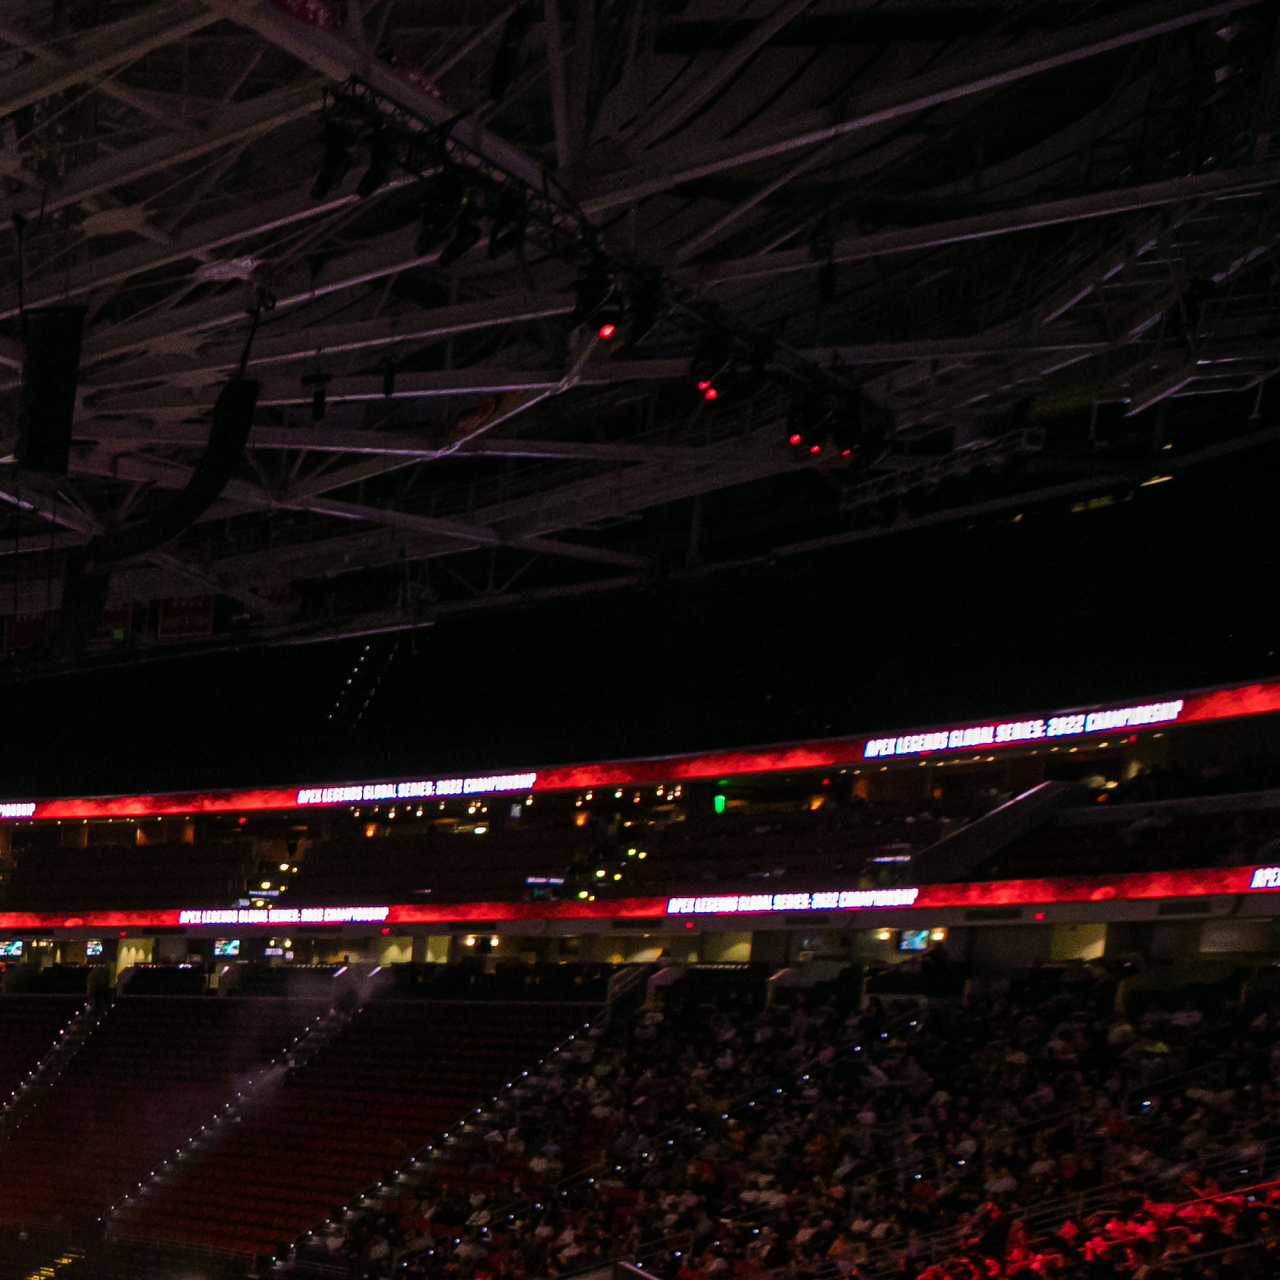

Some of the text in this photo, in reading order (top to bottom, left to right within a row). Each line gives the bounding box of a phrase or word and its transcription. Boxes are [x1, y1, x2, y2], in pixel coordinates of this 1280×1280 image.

[895, 732, 949, 755] LEGENDS
[948, 726, 994, 749] GLOBAL
[1046, 715, 1086, 737] 2022
[1085, 700, 1183, 733] CHAMPIONSHIP
[322, 786, 363, 803] LEGENDS
[435, 779, 463, 795] 2022
[463, 773, 536, 794] CHAMPIONSHIP
[839, 888, 919, 907] CHAMPIONSHIP
[324, 907, 389, 922] CHAMPIONSHIP
